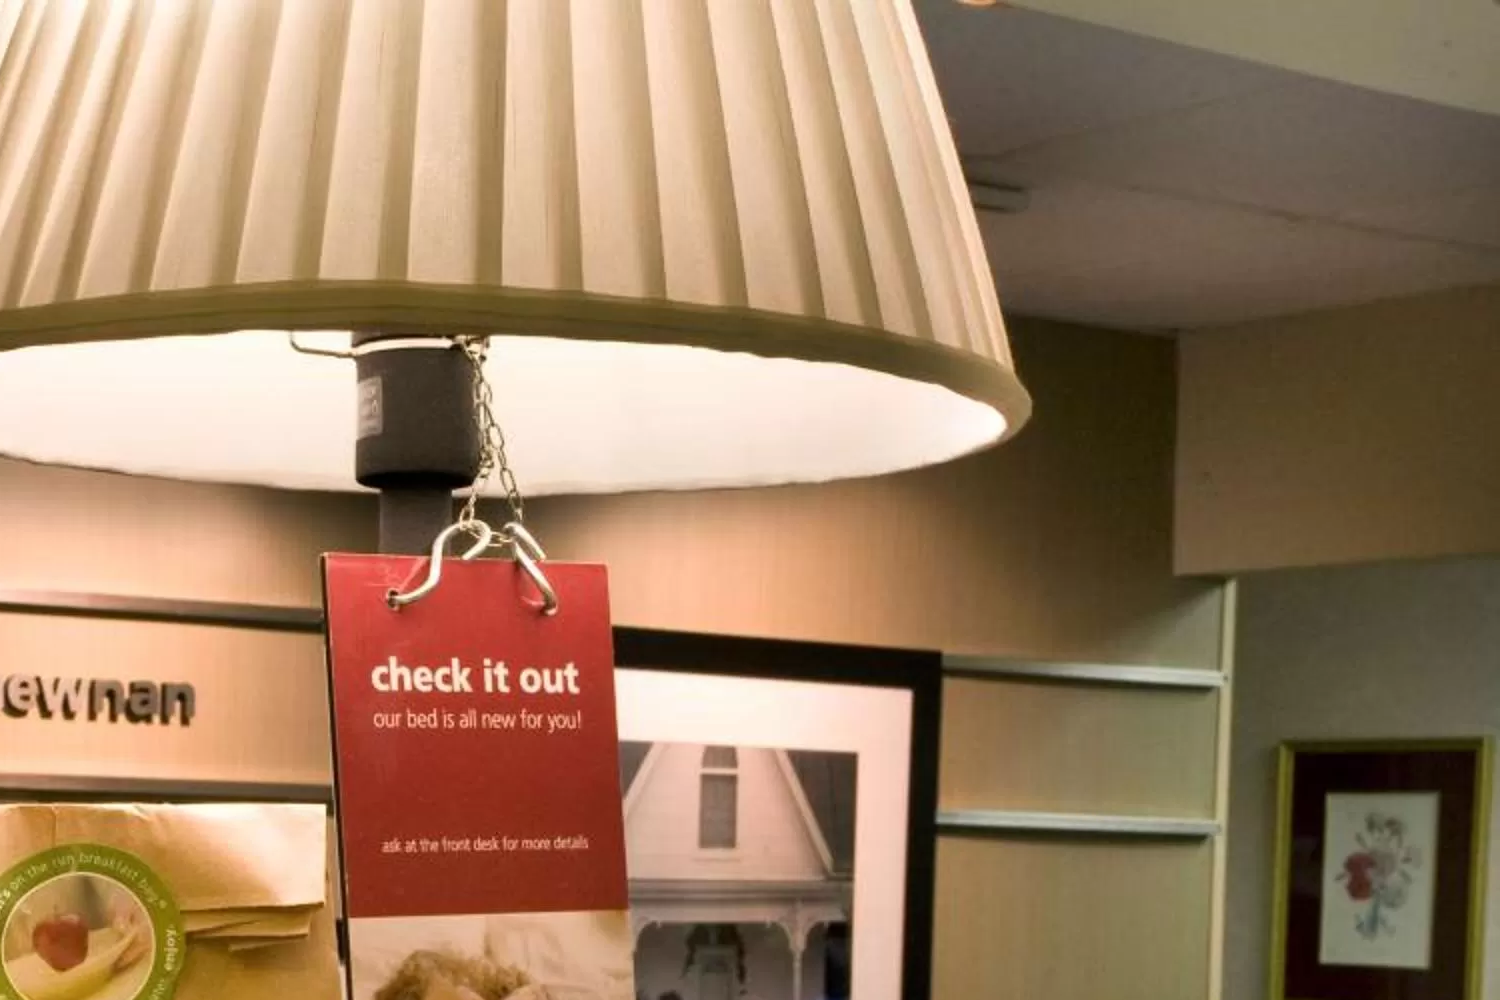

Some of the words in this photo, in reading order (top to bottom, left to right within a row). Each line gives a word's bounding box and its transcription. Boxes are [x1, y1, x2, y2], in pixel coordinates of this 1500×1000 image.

[371, 655, 474, 693] check
[483, 657, 511, 693] it
[519, 661, 581, 695] out
[373, 711, 401, 729] our
[406, 708, 438, 729] bed
[443, 710, 455, 729] is
[459, 708, 477, 729] all
[481, 711, 517, 729] new
[521, 708, 543, 730] for
[547, 709, 582, 733] you!
[381, 837, 401, 853] ask
[405, 838, 418, 853] at
[419, 837, 439, 853] the
[441, 836, 471, 853] front
[473, 835, 499, 852] desk
[502, 834, 519, 851] for
[521, 836, 551, 851] more
[553, 833, 589, 850] details
